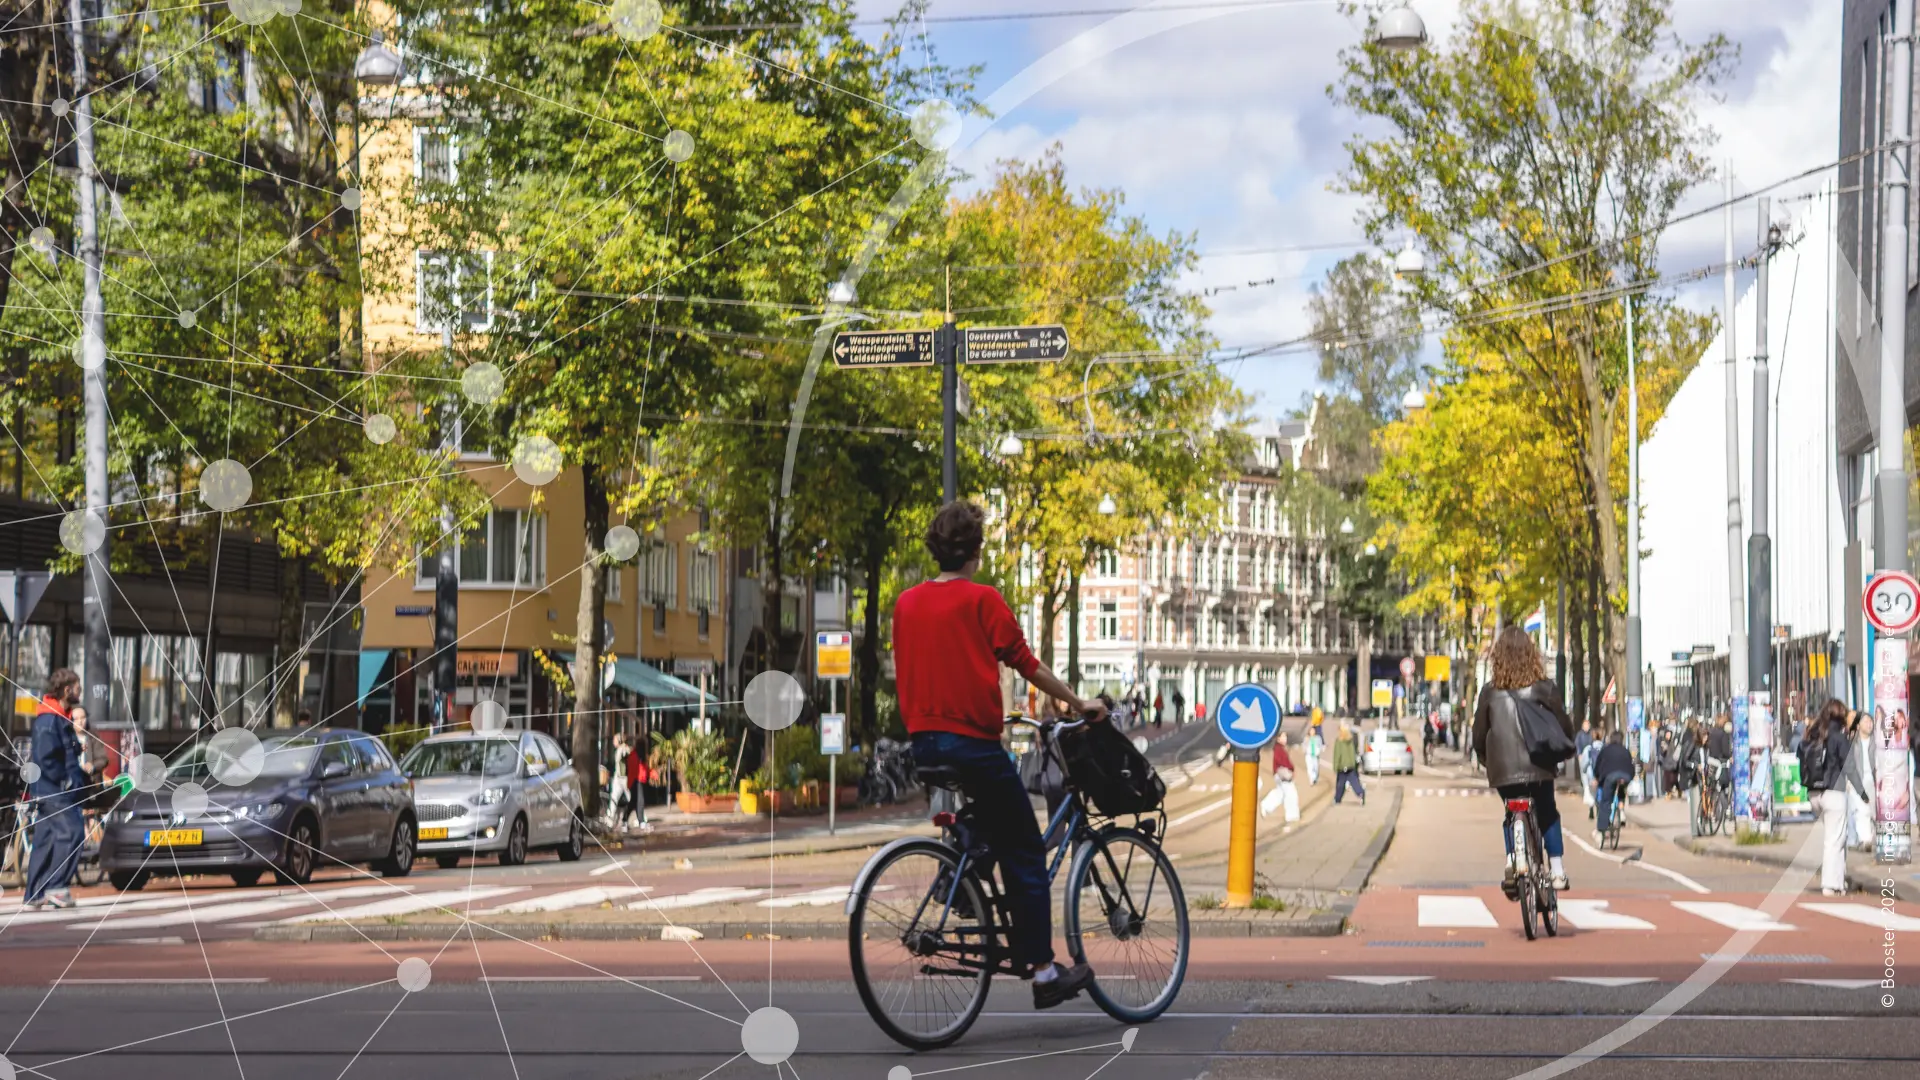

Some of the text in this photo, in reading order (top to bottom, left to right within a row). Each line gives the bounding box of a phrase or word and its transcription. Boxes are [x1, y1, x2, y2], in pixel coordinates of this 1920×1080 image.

[849, 334, 905, 344] Weesperplein
[969, 331, 1012, 342] Oosterpark
[849, 343, 907, 354] Waterlooplein
[969, 341, 1028, 350] Wereldmuseum
[849, 352, 896, 363] Leidseplein
[1876, 592, 1912, 612] 30
